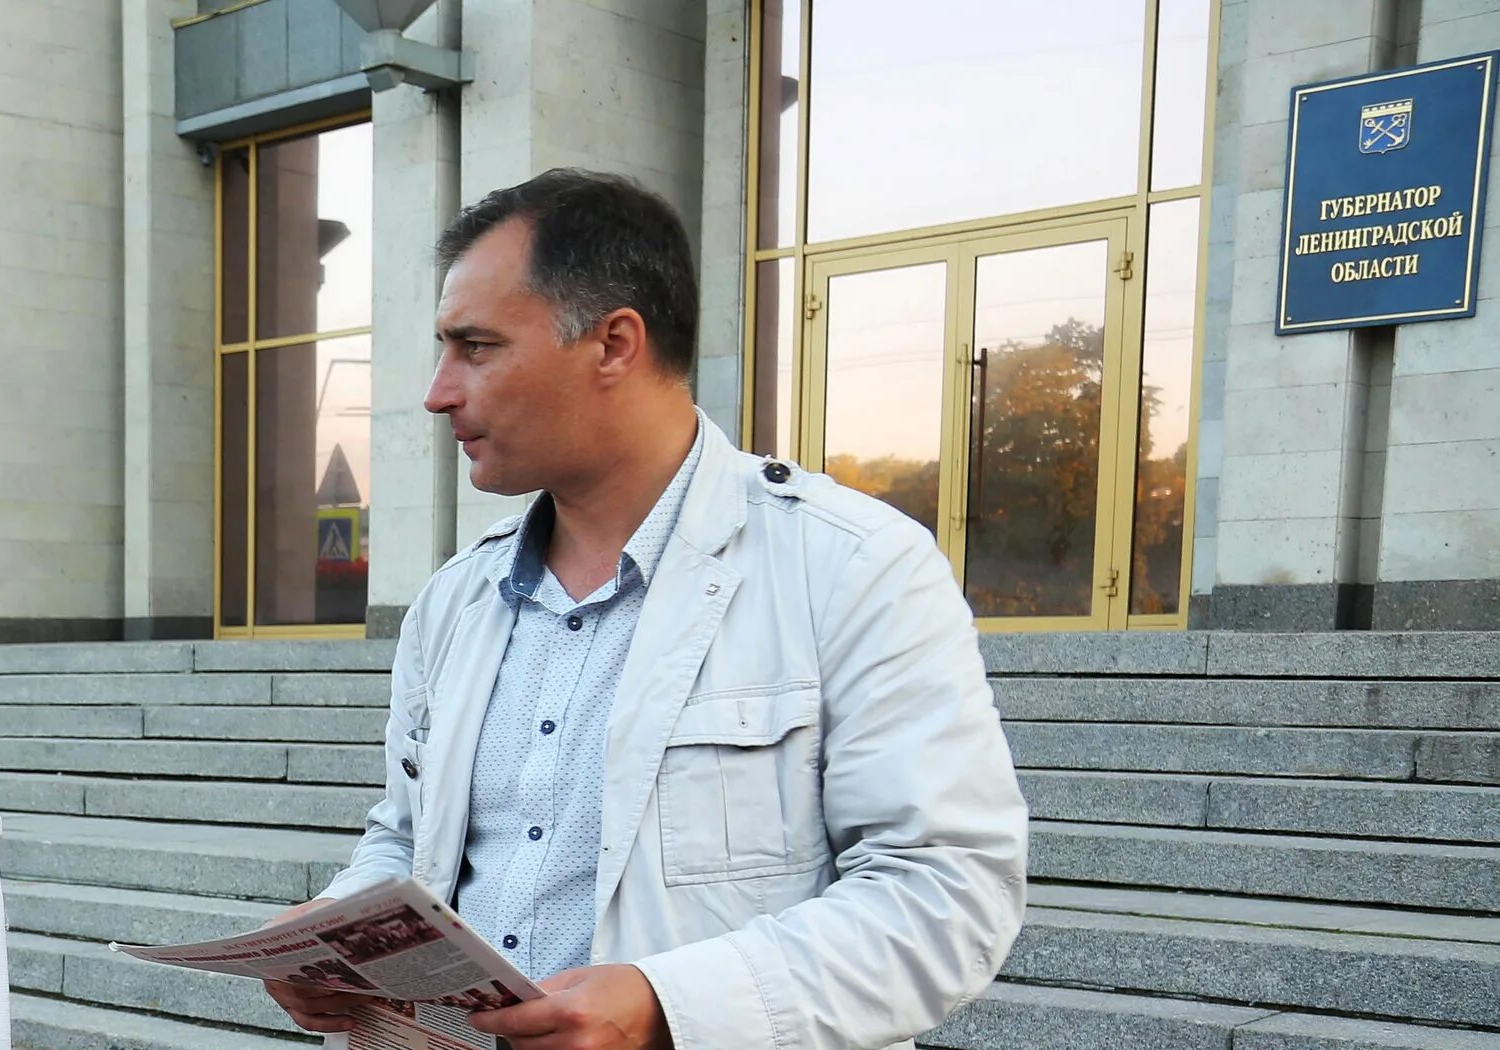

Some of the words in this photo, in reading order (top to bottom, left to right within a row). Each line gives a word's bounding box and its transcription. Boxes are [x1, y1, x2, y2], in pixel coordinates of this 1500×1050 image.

[1320, 185, 1441, 221] ГУБЕРНАТОР
[1296, 211, 1464, 256] ЛЕНИНГРАДСКОЙ
[1331, 254, 1419, 283] ОБЛАСТИ
